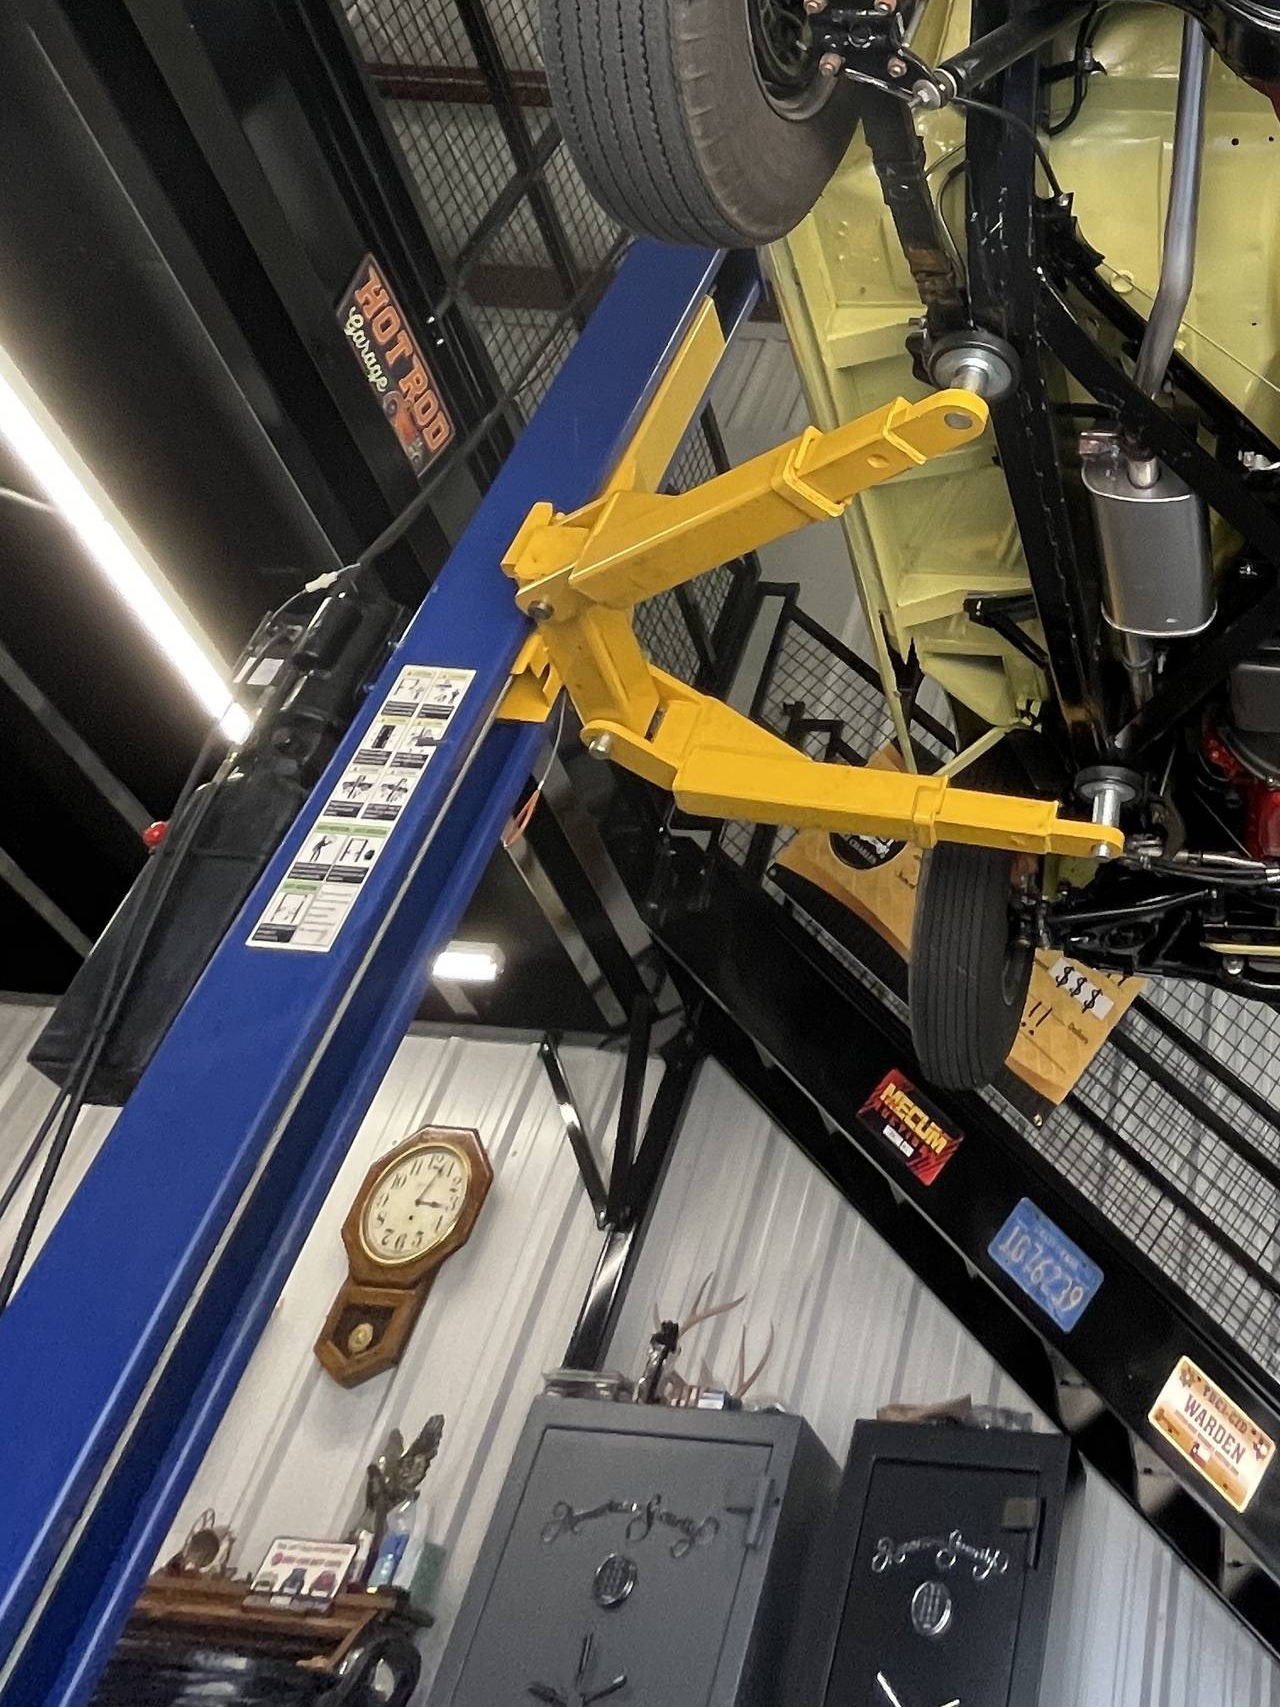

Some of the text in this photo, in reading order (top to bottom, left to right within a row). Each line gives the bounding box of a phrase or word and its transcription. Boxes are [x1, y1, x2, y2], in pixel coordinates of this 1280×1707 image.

[343, 306, 389, 392] Garage
[355, 278, 450, 453] HOT ROD
[880, 1082, 949, 1154] MECUM
[391, 1173, 407, 1189] 10
[381, 1228, 395, 1246] 7
[1184, 1394, 1246, 1464] WARDEN
